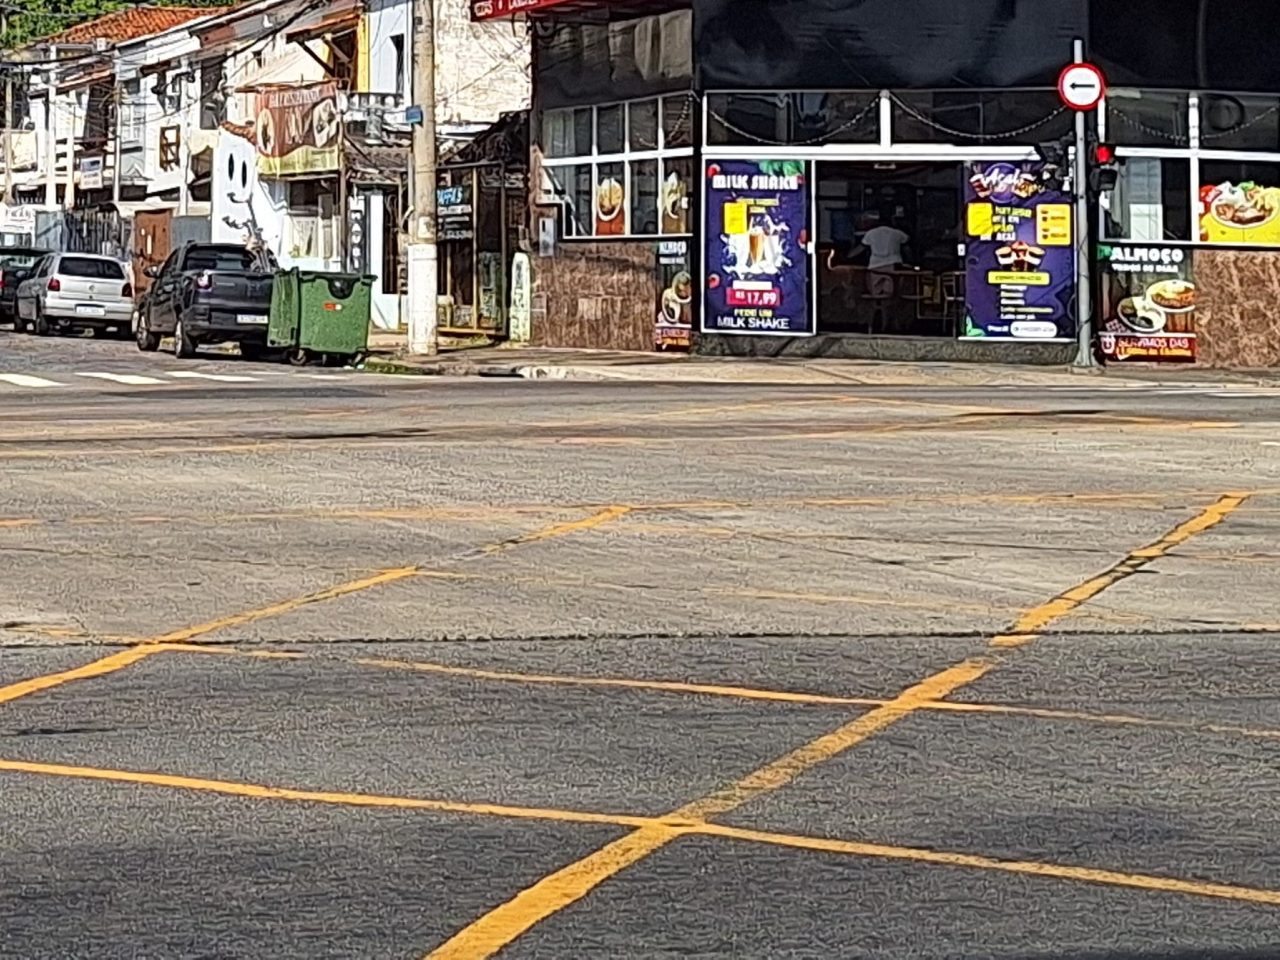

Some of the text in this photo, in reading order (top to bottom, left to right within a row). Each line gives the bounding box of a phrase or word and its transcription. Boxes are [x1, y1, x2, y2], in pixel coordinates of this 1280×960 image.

[712, 174, 799, 190] MILK SHAKE
[1109, 246, 1184, 265] ALMOÇO
[717, 316, 791, 330] MILK SHAKE
